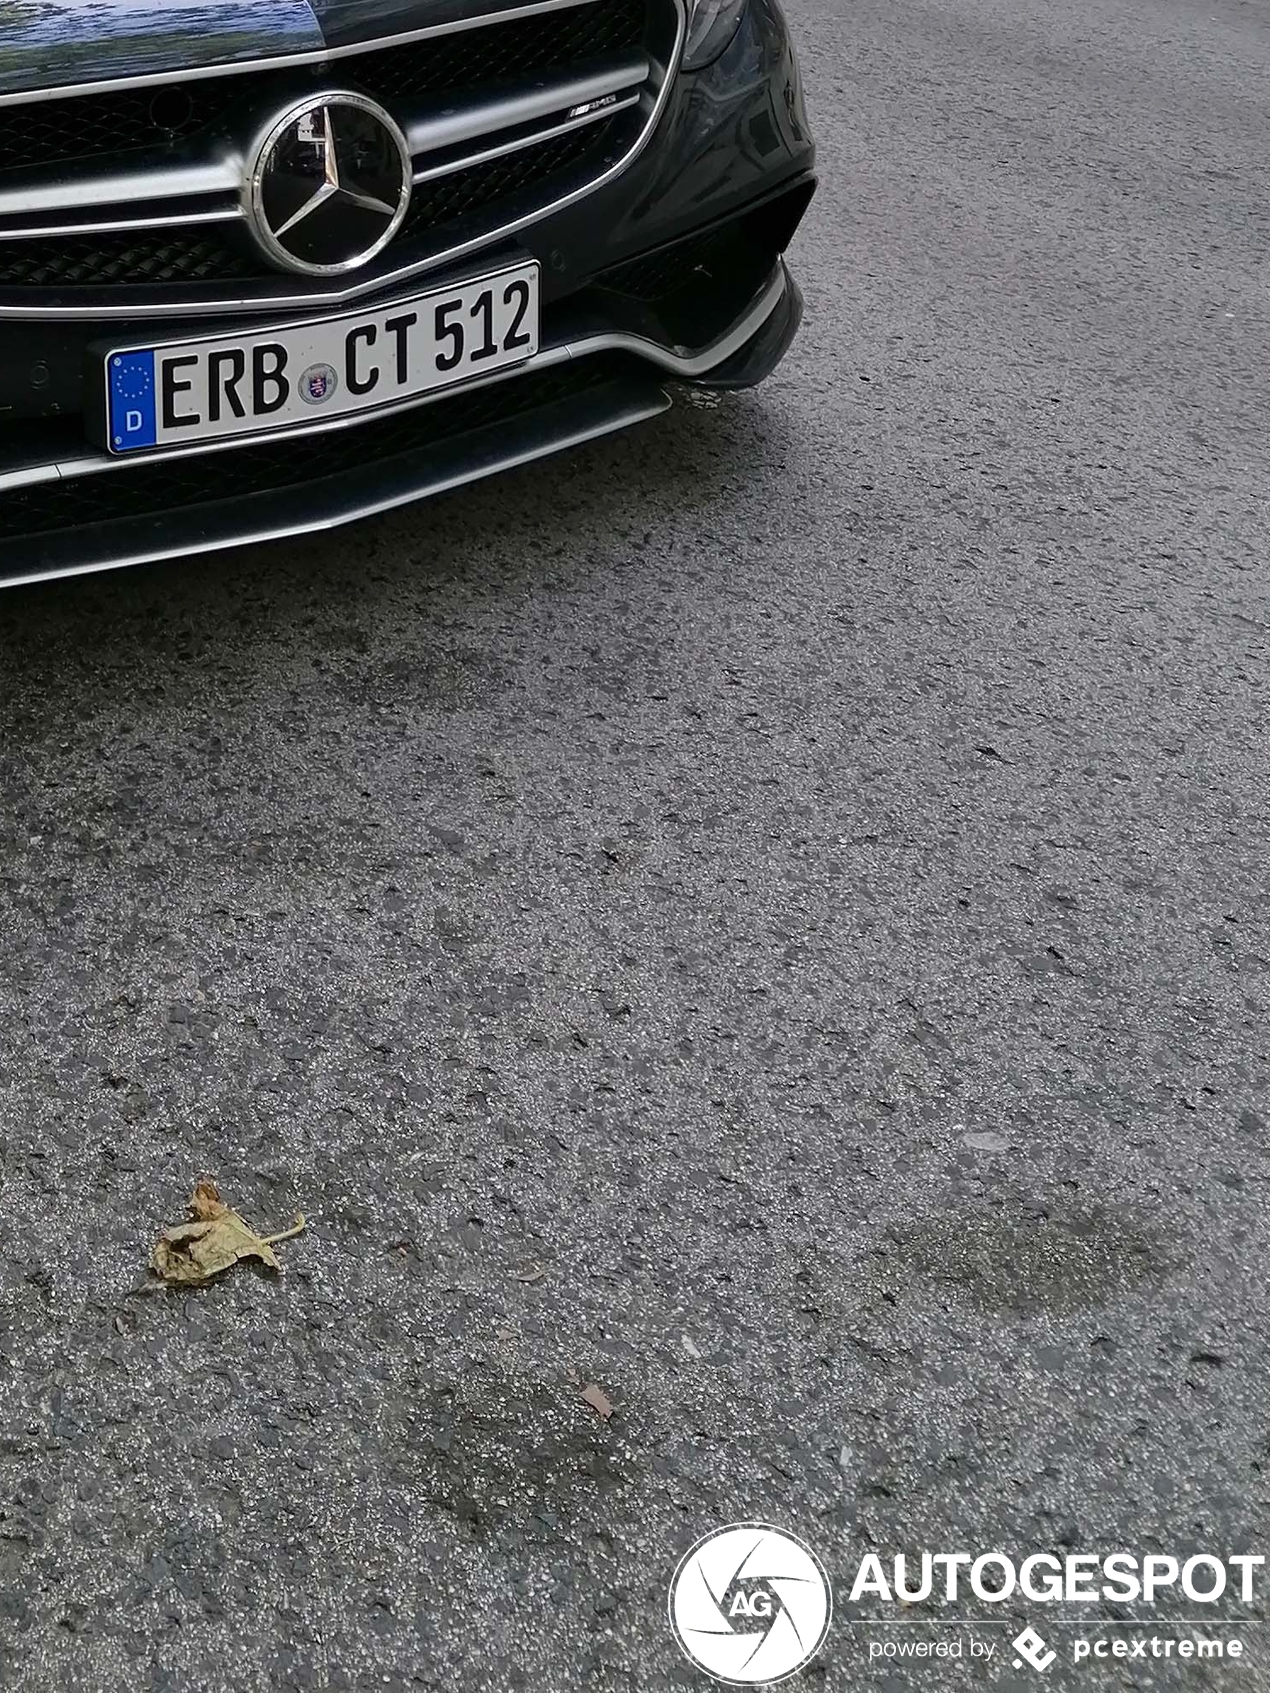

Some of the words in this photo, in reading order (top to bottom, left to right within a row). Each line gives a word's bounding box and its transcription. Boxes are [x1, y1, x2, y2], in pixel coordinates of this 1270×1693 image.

[160, 342, 290, 429] ERB
[345, 313, 418, 396] CT
[434, 280, 531, 372] 512
[126, 410, 143, 432] D
